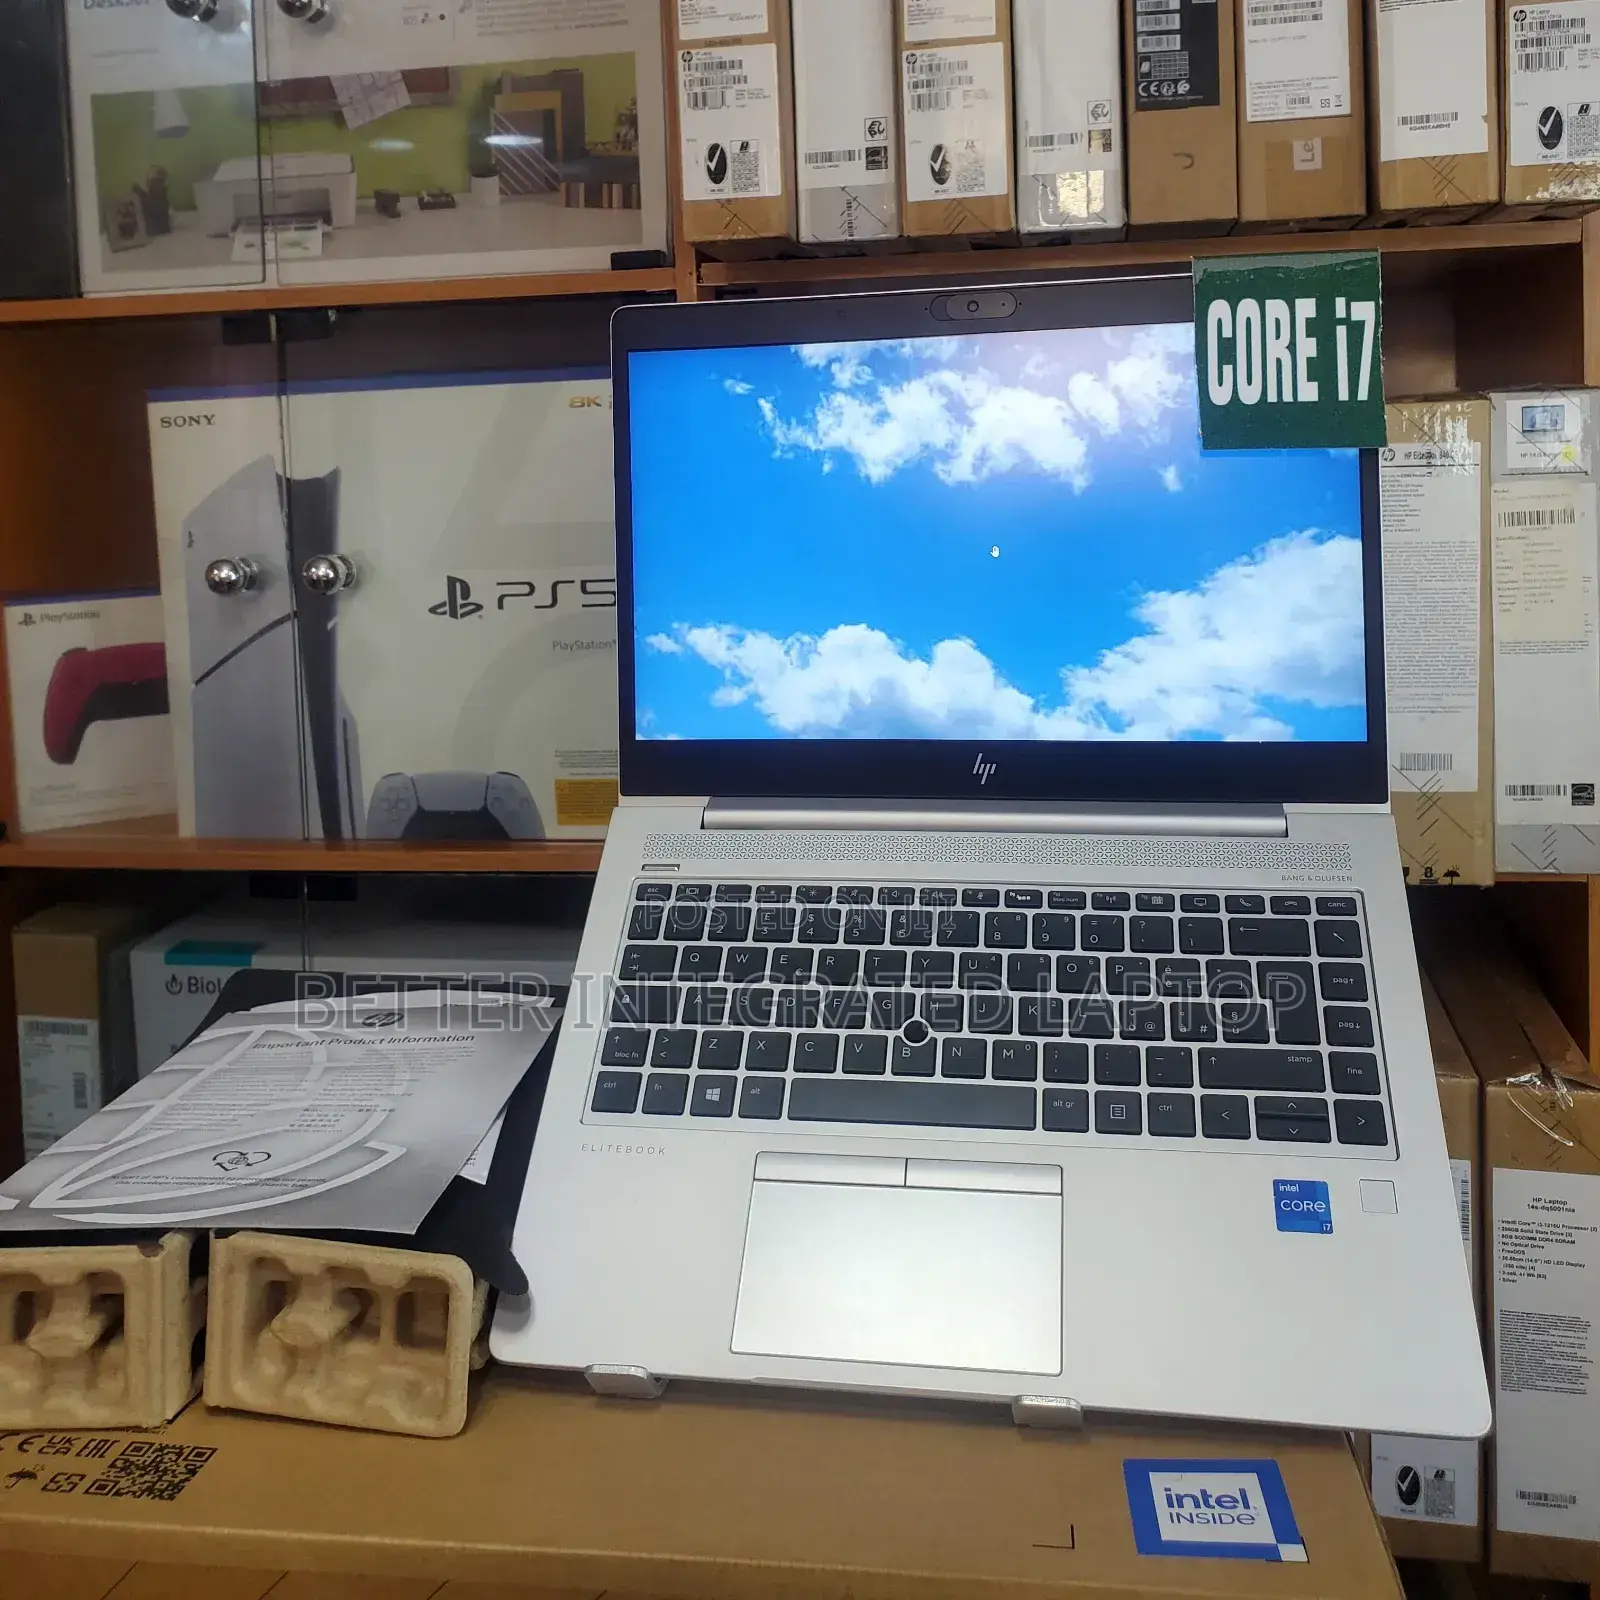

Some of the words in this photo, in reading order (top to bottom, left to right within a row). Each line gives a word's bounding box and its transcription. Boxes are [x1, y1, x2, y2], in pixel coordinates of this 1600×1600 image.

[1207, 298, 1319, 406] CORE
[1335, 296, 1376, 401] i7
[569, 396, 602, 408] 8K
[160, 414, 215, 428] SONY
[496, 578, 616, 610] PS5
[41, 611, 100, 624] PlayStation
[972, 752, 997, 785] hp
[716, 926, 724, 934] 2
[806, 927, 814, 936] 4
[852, 929, 860, 937] 5
[899, 930, 906, 938] 6
[946, 931, 953, 939] 7
[994, 932, 1001, 940] 8
[1041, 933, 1050, 942] 9
[690, 953, 700, 962] Q
[735, 954, 749, 963] W
[780, 955, 788, 964] E
[826, 956, 835, 965] R
[873, 957, 881, 967] T
[921, 958, 930, 968] Y
[969, 959, 978, 969] U
[1115, 965, 1124, 974] P
[693, 995, 704, 1004] A
[740, 996, 748, 1005] S
[786, 997, 795, 1006] D
[833, 998, 841, 1008] F
[882, 1000, 892, 1009] G
[930, 1001, 939, 1010] H
[979, 1003, 986, 1013] J
[1029, 1005, 1038, 1015] K
[1144, 1022, 1156, 1031] @
[1199, 1024, 1208, 1033] #
[252, 1038, 326, 1049] Important
[328, 1036, 385, 1046] Product
[387, 1033, 475, 1045] Information
[709, 1039, 718, 1048] Z
[756, 1040, 766, 1050] X
[805, 1042, 814, 1051] C
[854, 1043, 863, 1053] V
[614, 1050, 629, 1058] bloc
[902, 1047, 911, 1057] B
[952, 1047, 961, 1057] N
[1003, 1049, 1014, 1059] M
[1287, 1055, 1313, 1063] stamp
[1347, 1067, 1363, 1075] fine
[603, 1081, 616, 1089] ctrl
[750, 1087, 761, 1095] alt
[1158, 1104, 1173, 1112] ctrl
[581, 1143, 667, 1155] ELITEBOOK
[1279, 1183, 1299, 1192] intel
[1544, 1198, 1568, 1206] Laptop
[1322, 1223, 1331, 1231] i7
